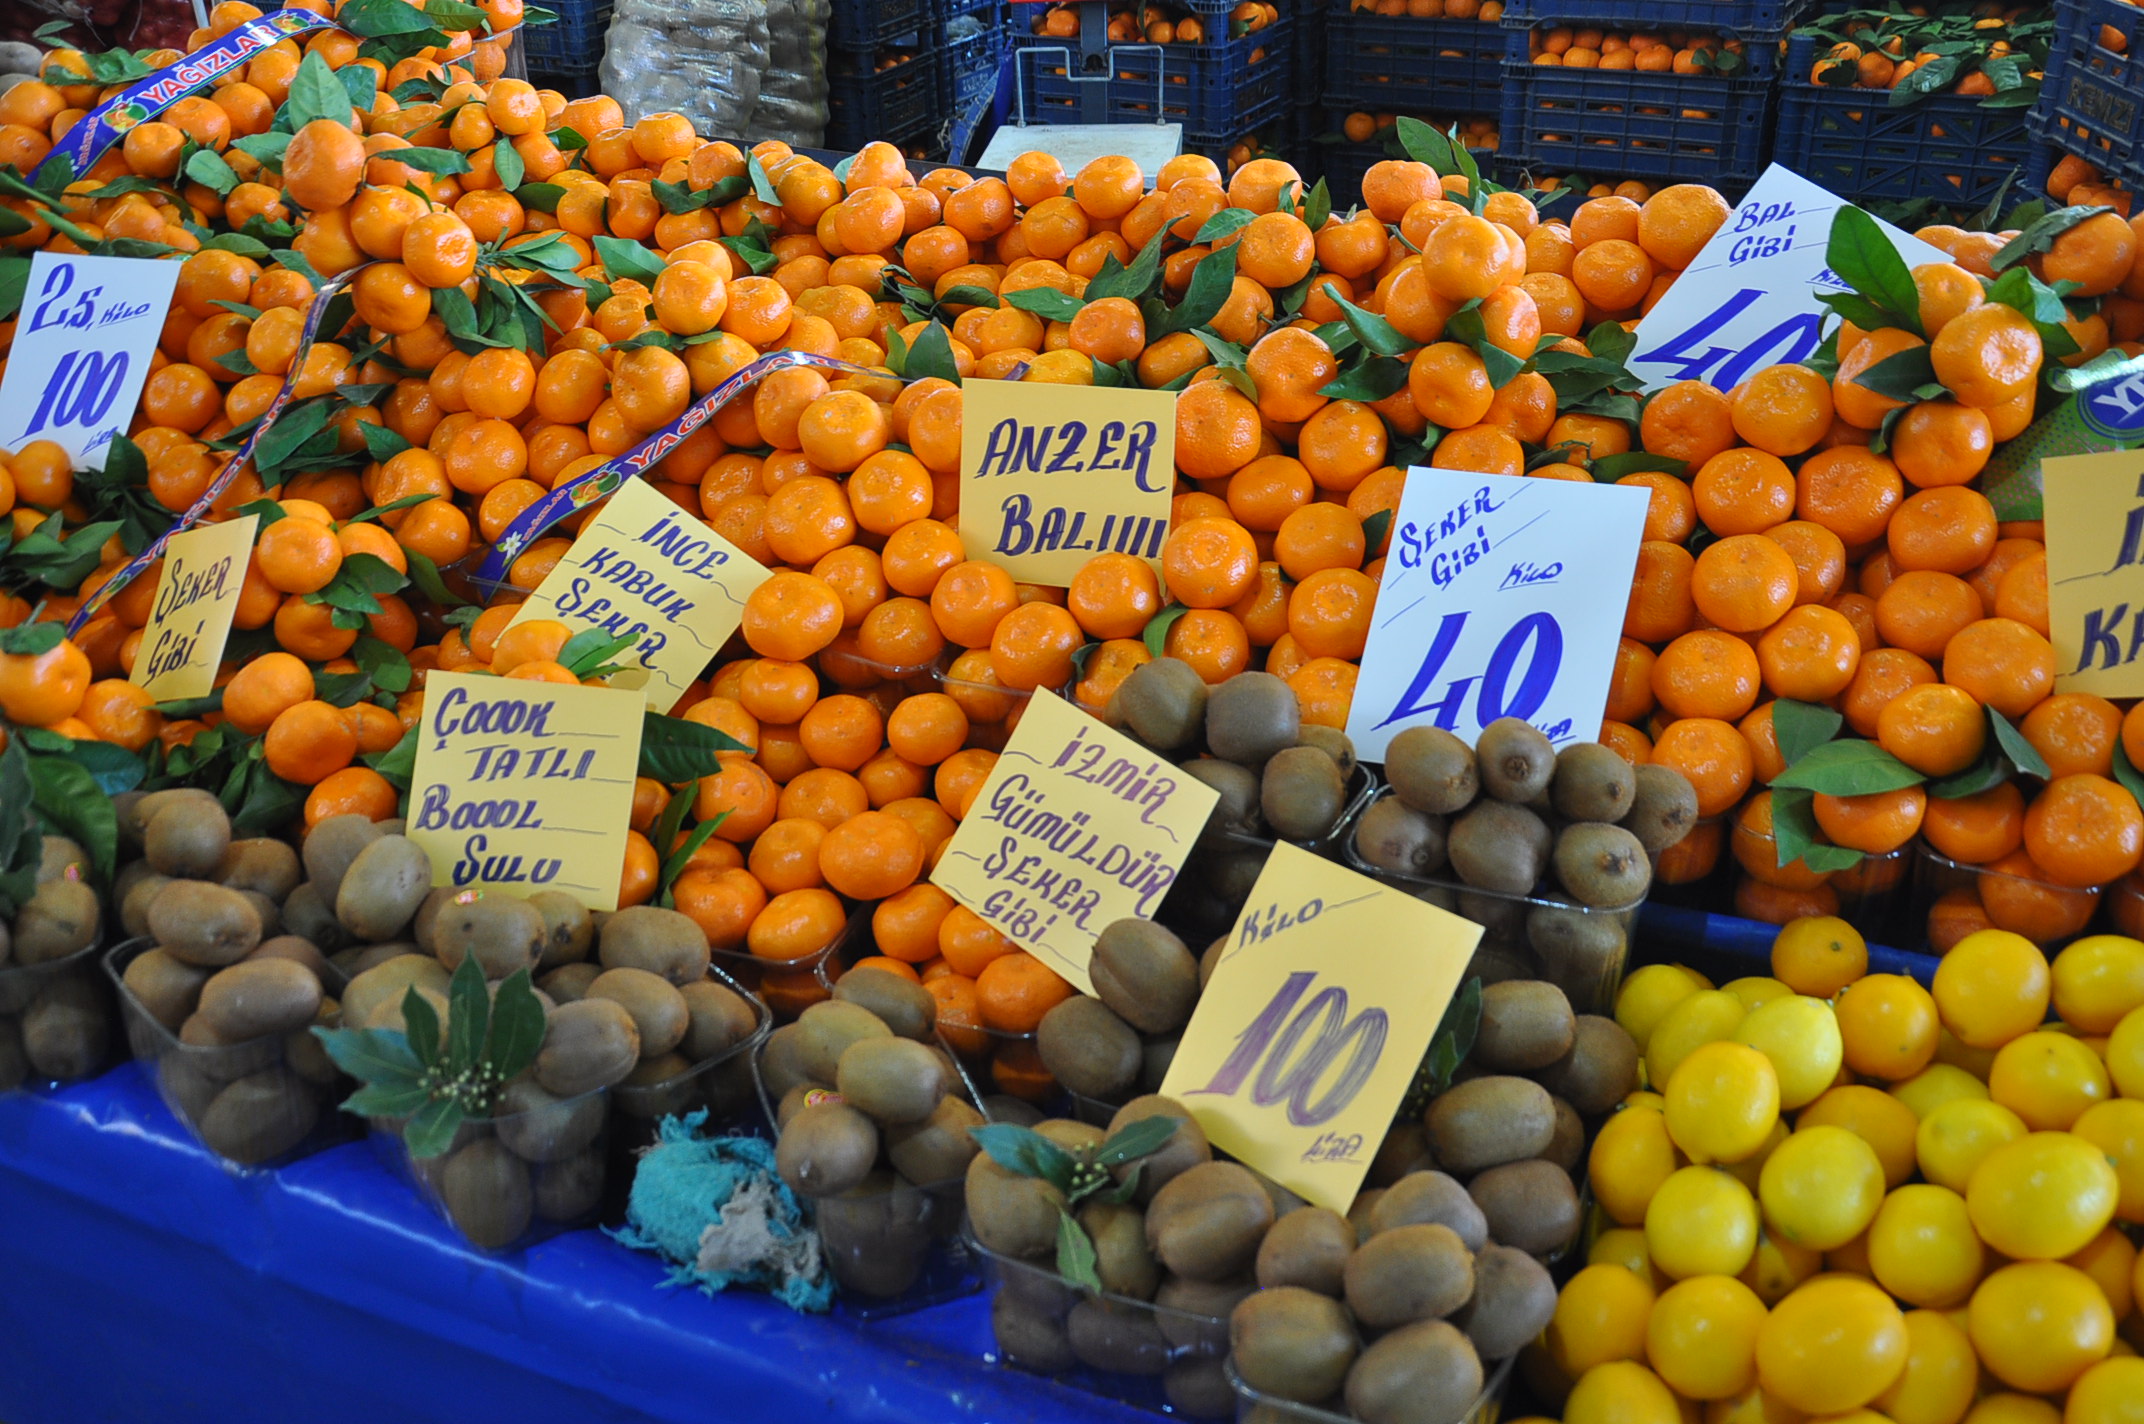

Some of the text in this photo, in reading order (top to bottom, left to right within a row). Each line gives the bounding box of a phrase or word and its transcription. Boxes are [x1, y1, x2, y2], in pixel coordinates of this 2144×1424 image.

[140, 24, 280, 106] YAĞIZLAR
[1733, 201, 1796, 233] BAL
[1633, 288, 1822, 394] 40
[14, 350, 130, 442] 100
[973, 418, 1166, 493] ANZER
[631, 511, 730, 580] İNCE
[1399, 486, 1506, 568] ŞEKER
[579, 547, 695, 623] KABUK
[1370, 611, 1563, 732] 40
[433, 687, 556, 751] ÇOOOK
[465, 744, 596, 782] TATLI
[1049, 726, 1177, 825] İZMİR
[413, 784, 543, 831] BOOOL
[981, 774, 1176, 918] GÜMÜLDÜR
[452, 834, 562, 886] SULU
[982, 836, 1101, 931] ŞEKER
[1186, 971, 1389, 1127] 100
